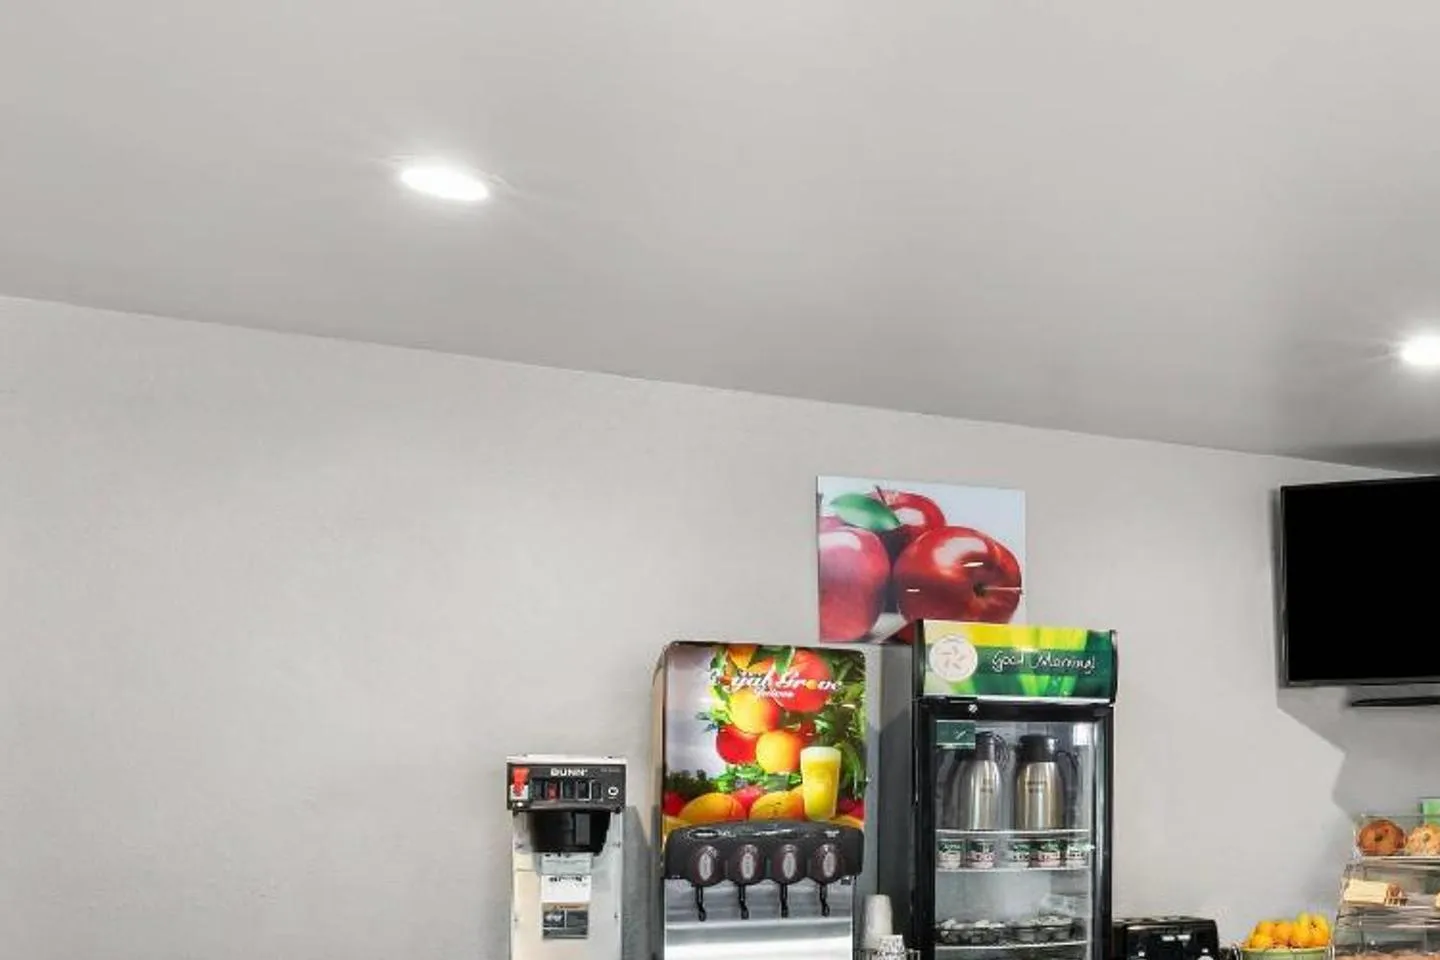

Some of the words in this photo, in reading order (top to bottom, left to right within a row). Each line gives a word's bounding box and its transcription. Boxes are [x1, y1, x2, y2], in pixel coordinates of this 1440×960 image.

[991, 650, 1025, 673] Good
[1029, 651, 1096, 675] Morning!
[550, 767, 586, 777] BUNN
